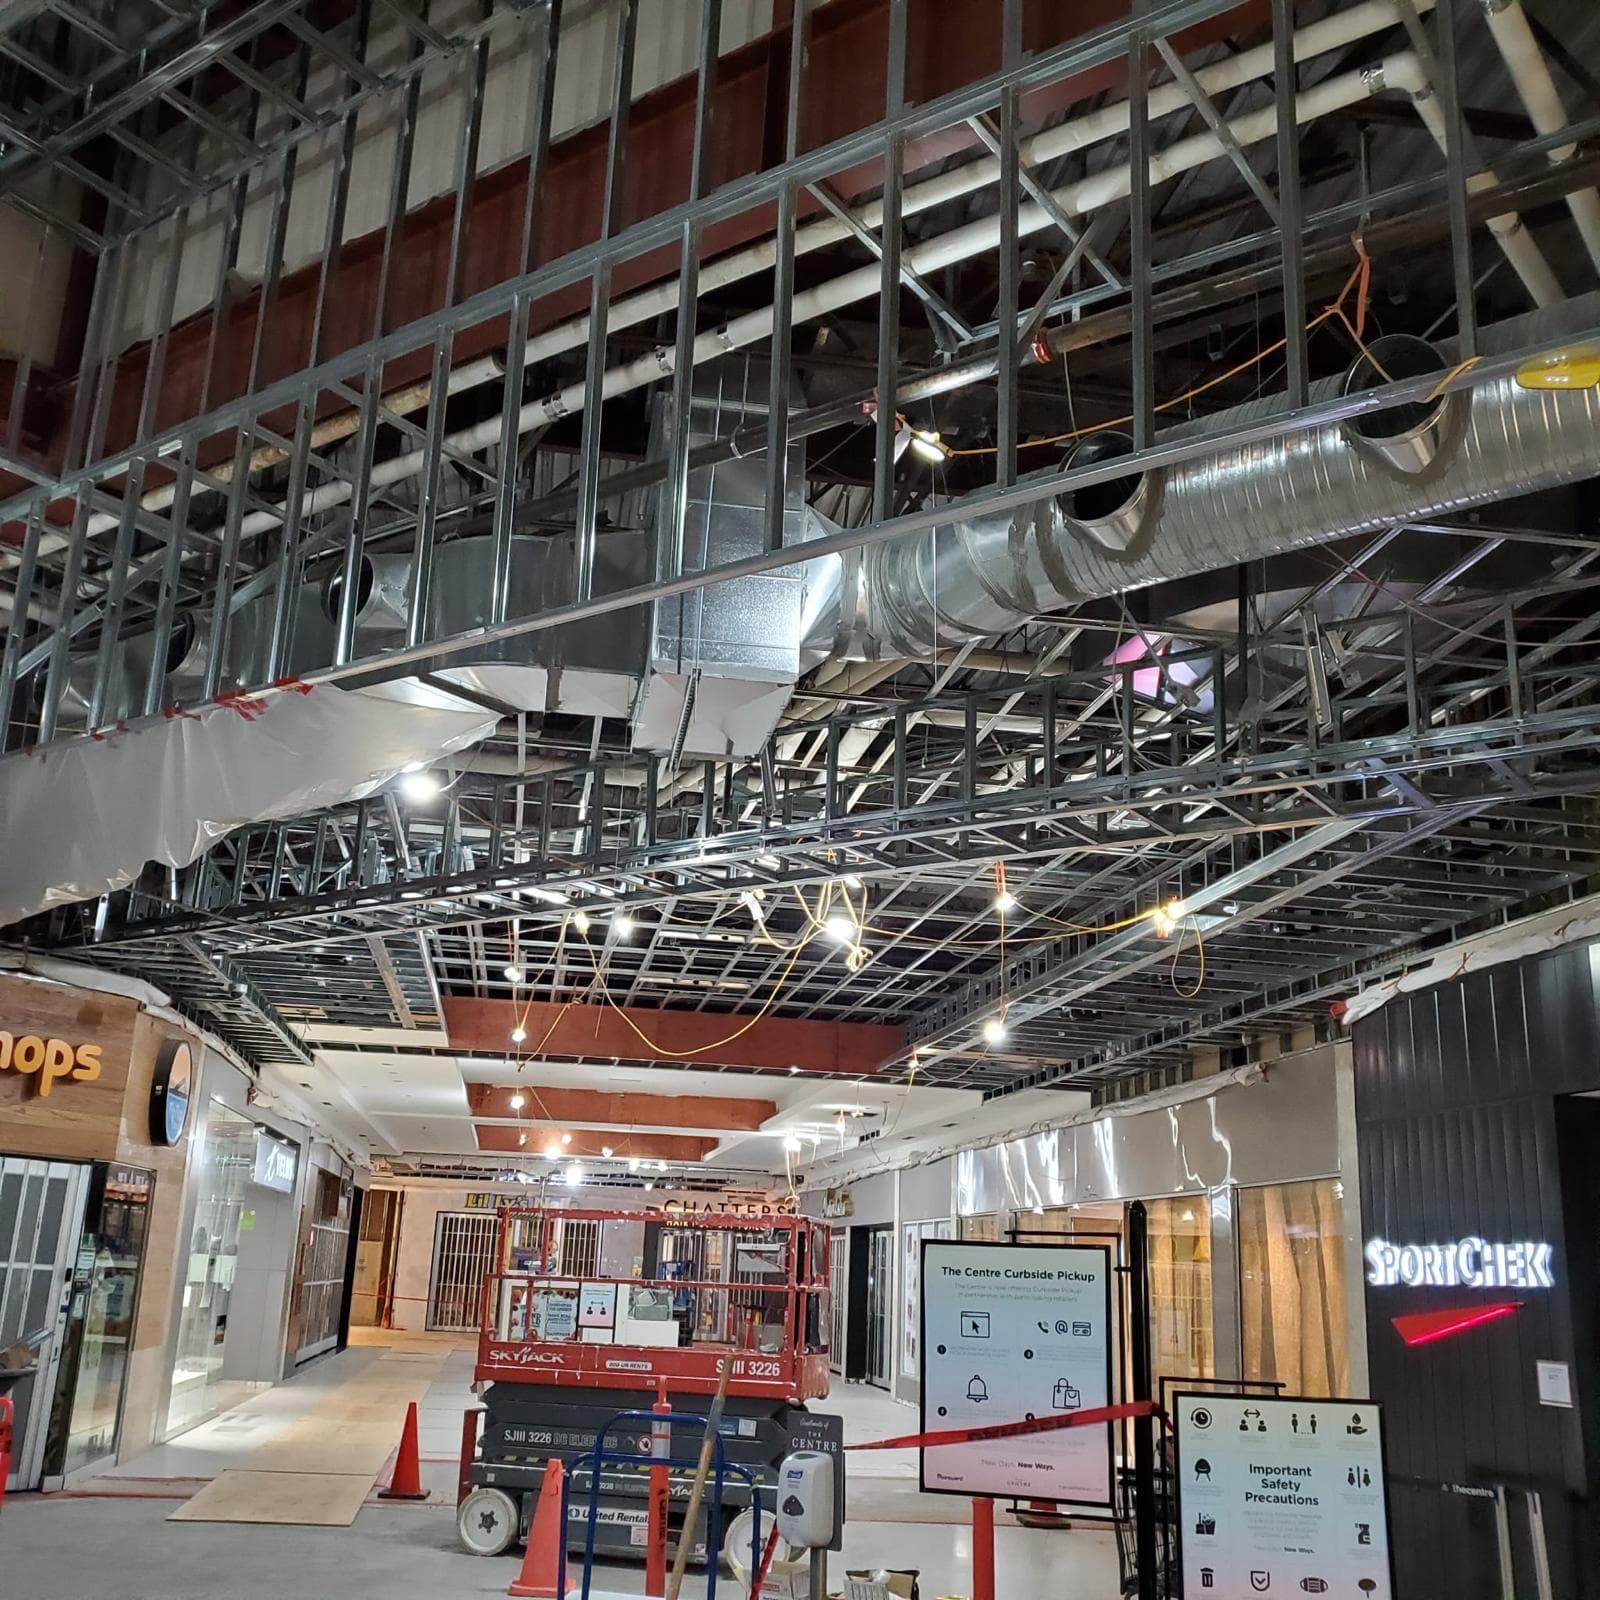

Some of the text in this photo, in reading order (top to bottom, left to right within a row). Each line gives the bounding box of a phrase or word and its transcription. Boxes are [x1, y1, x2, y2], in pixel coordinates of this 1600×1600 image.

[664, 1199, 786, 1214] CHATTERS
[942, 1266, 1095, 1283] The Centre Curbside Pickup
[489, 1347, 565, 1364] SKYJACK
[716, 1359, 780, 1376] SIII 3226
[504, 1430, 526, 1442] SJIII
[528, 1431, 552, 1444] 3226
[792, 1437, 838, 1452] CENTRE
[1035, 1463, 1055, 1471] Ways.
[1249, 1464, 1312, 1477] Important
[1261, 1479, 1301, 1492] Safety
[1245, 1491, 1319, 1506] Precautions
[582, 1509, 650, 1523] Uited Rental
